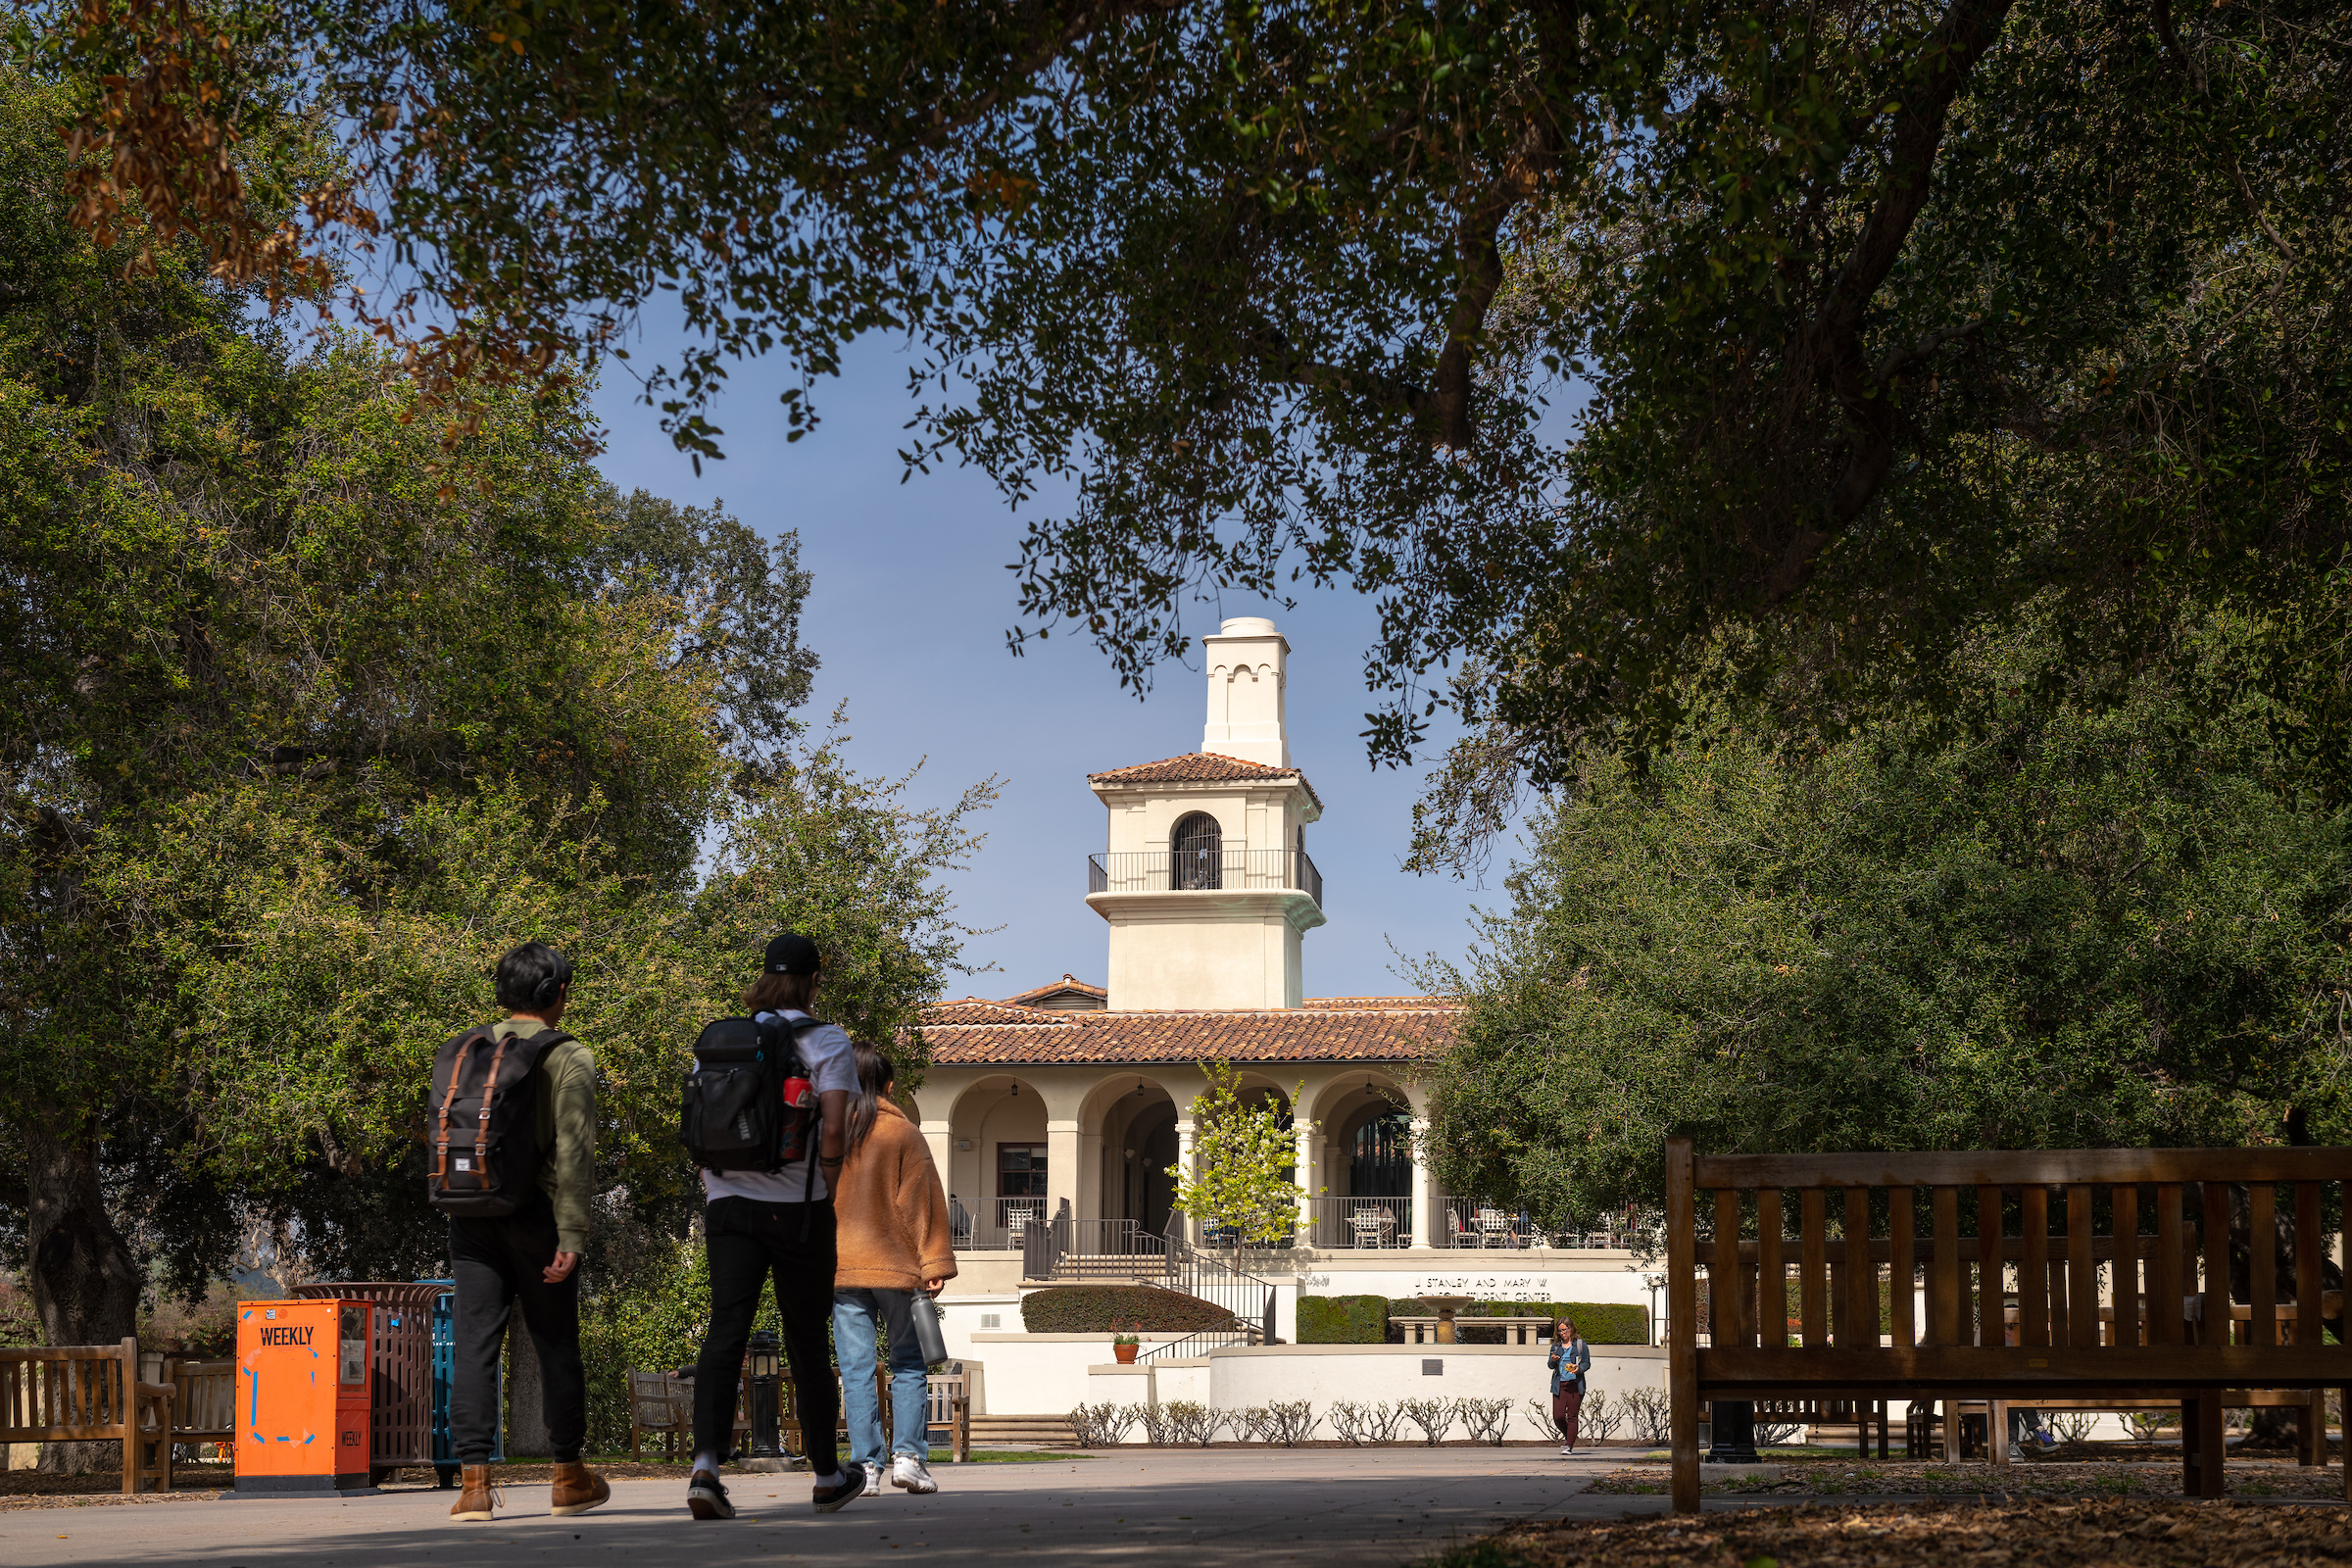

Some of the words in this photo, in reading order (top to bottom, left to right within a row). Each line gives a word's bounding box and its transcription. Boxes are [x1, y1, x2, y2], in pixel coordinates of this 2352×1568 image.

[1426, 1278, 1469, 1288] STANLEY
[1475, 1278, 1497, 1288] AND
[1503, 1278, 1532, 1288] MARY
[1466, 1292, 1508, 1301] STUDENT
[1514, 1292, 1551, 1302] CENTER
[260, 1326, 315, 1347] WEEKLY
[341, 1430, 363, 1446] WEEKLY
